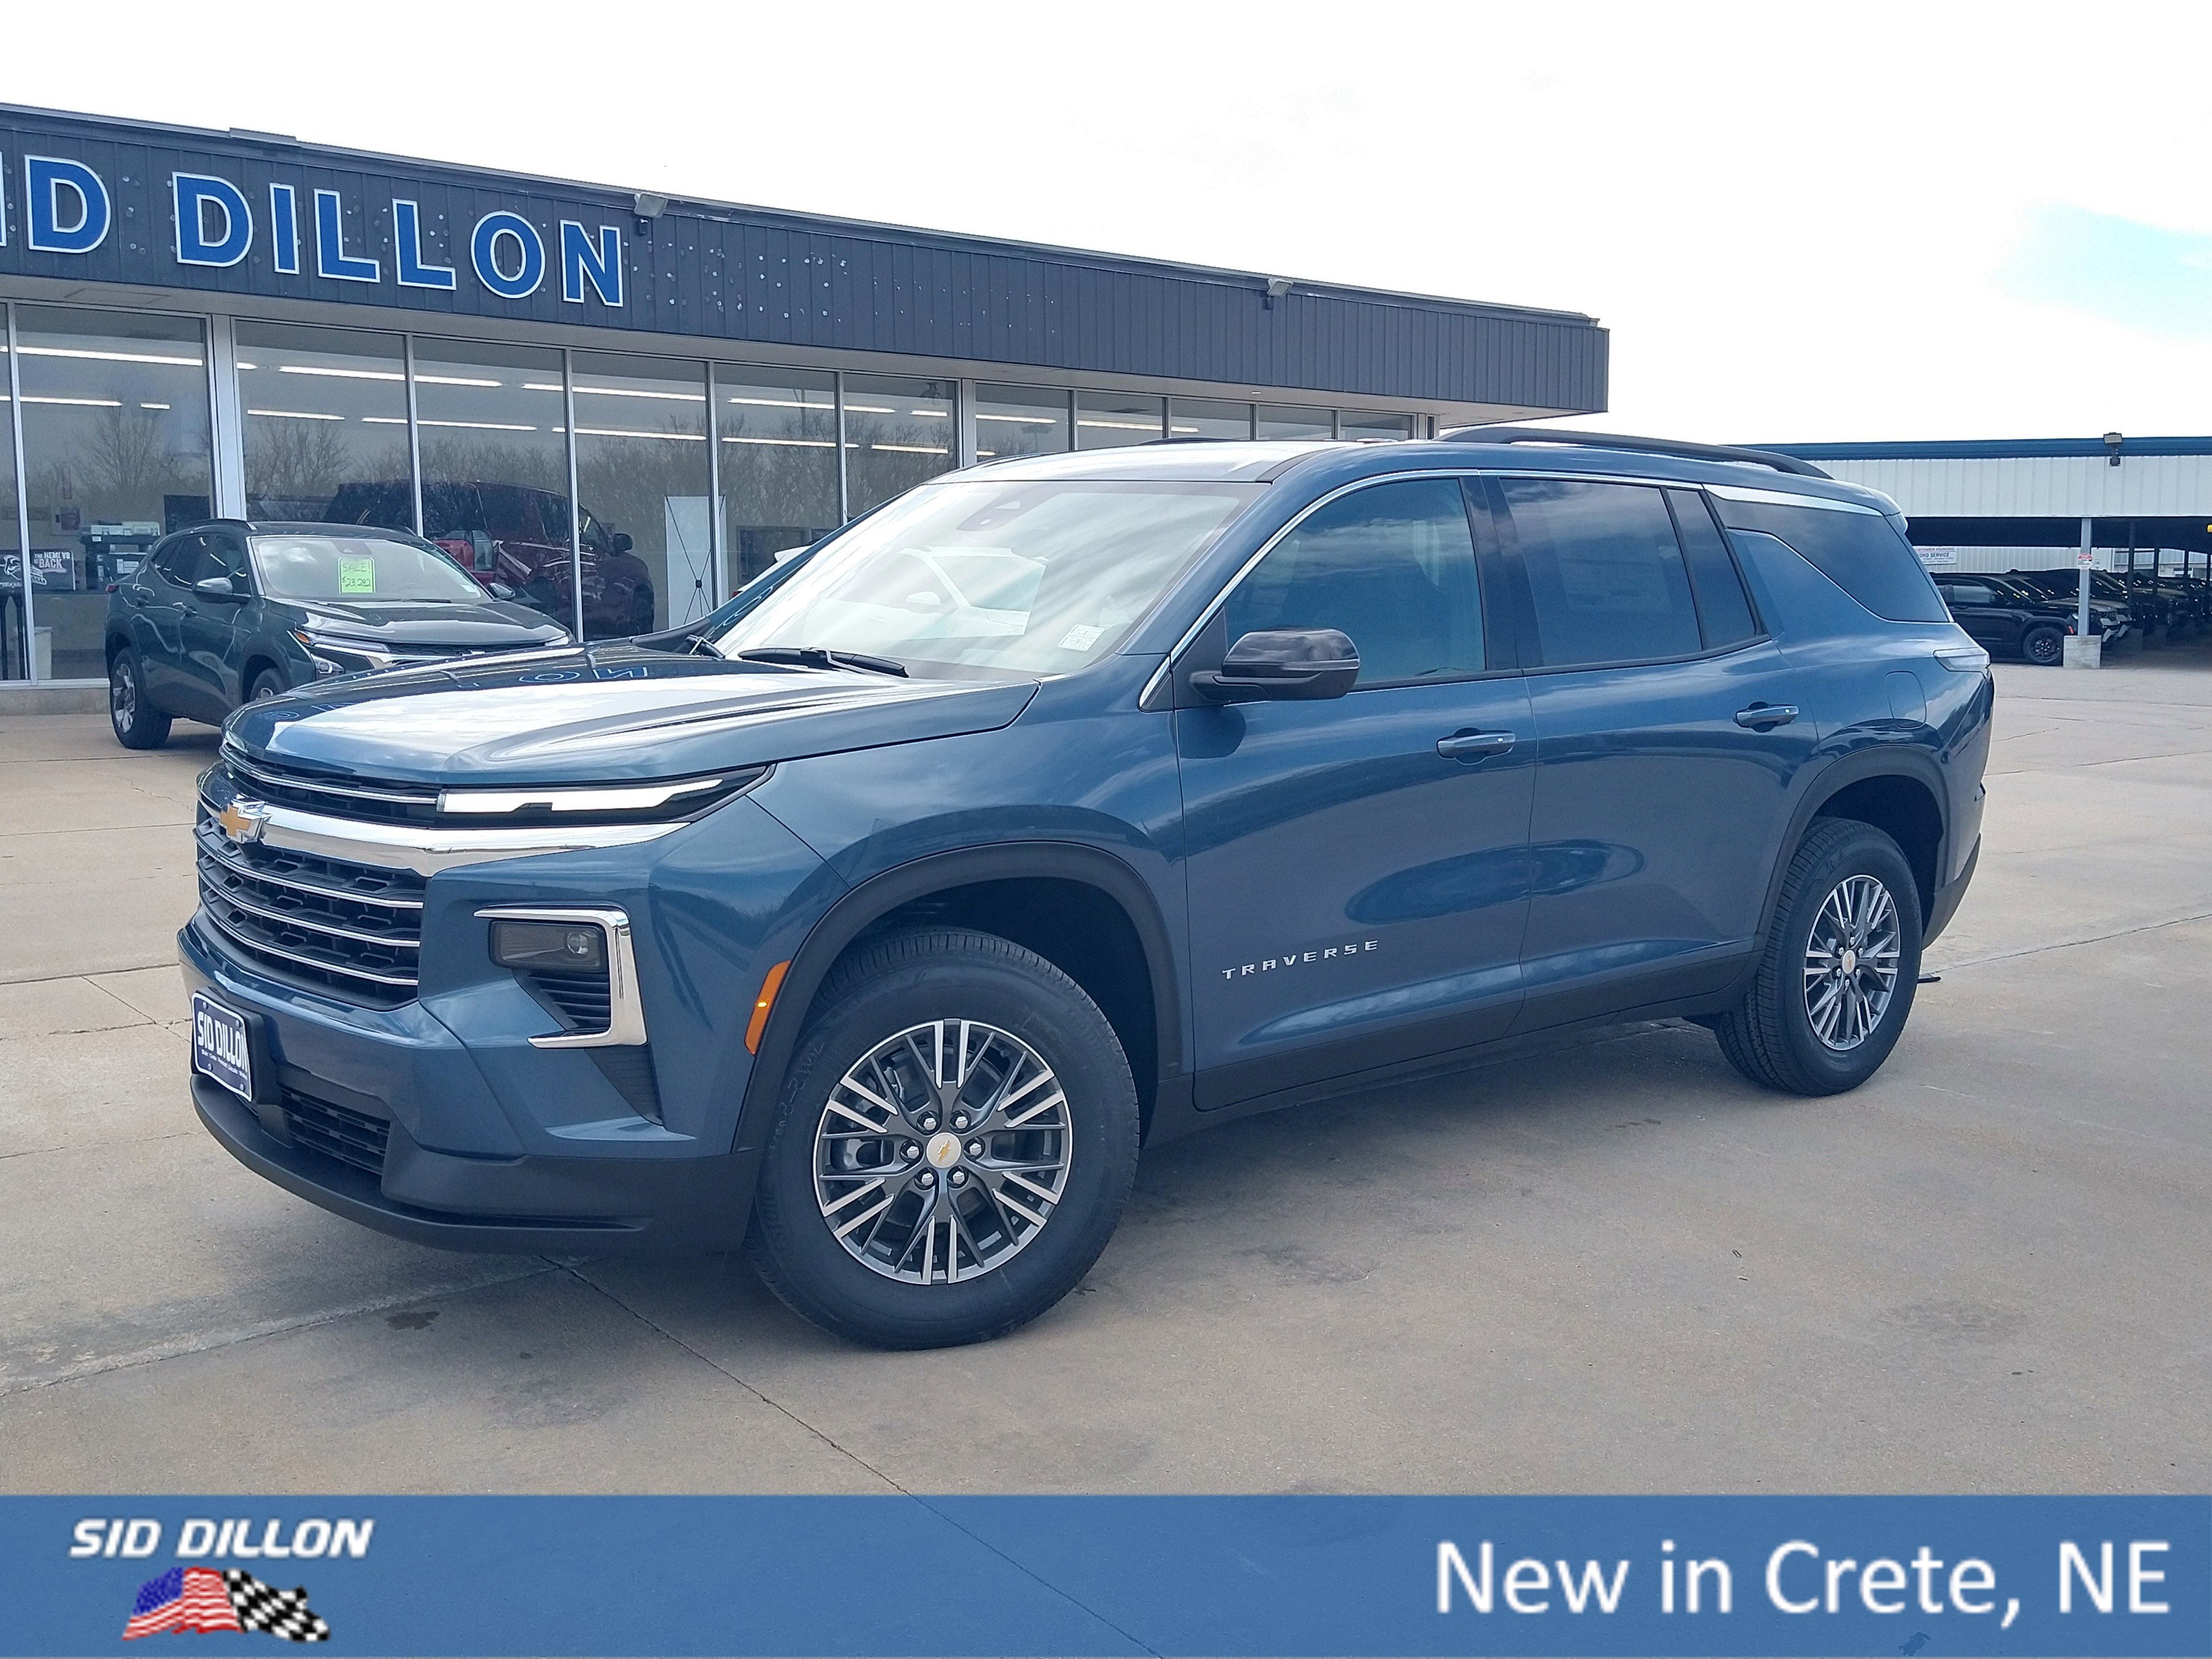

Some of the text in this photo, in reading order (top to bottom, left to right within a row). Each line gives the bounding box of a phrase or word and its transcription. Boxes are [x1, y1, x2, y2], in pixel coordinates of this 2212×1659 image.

[0, 151, 624, 307] D DILLON
[39, 559, 62, 568] BACK
[342, 560, 370, 573] SALE!
[1222, 940, 1379, 979] TRAVERSE
[197, 1011, 215, 1052] SID
[214, 1019, 248, 1073] DILLON
